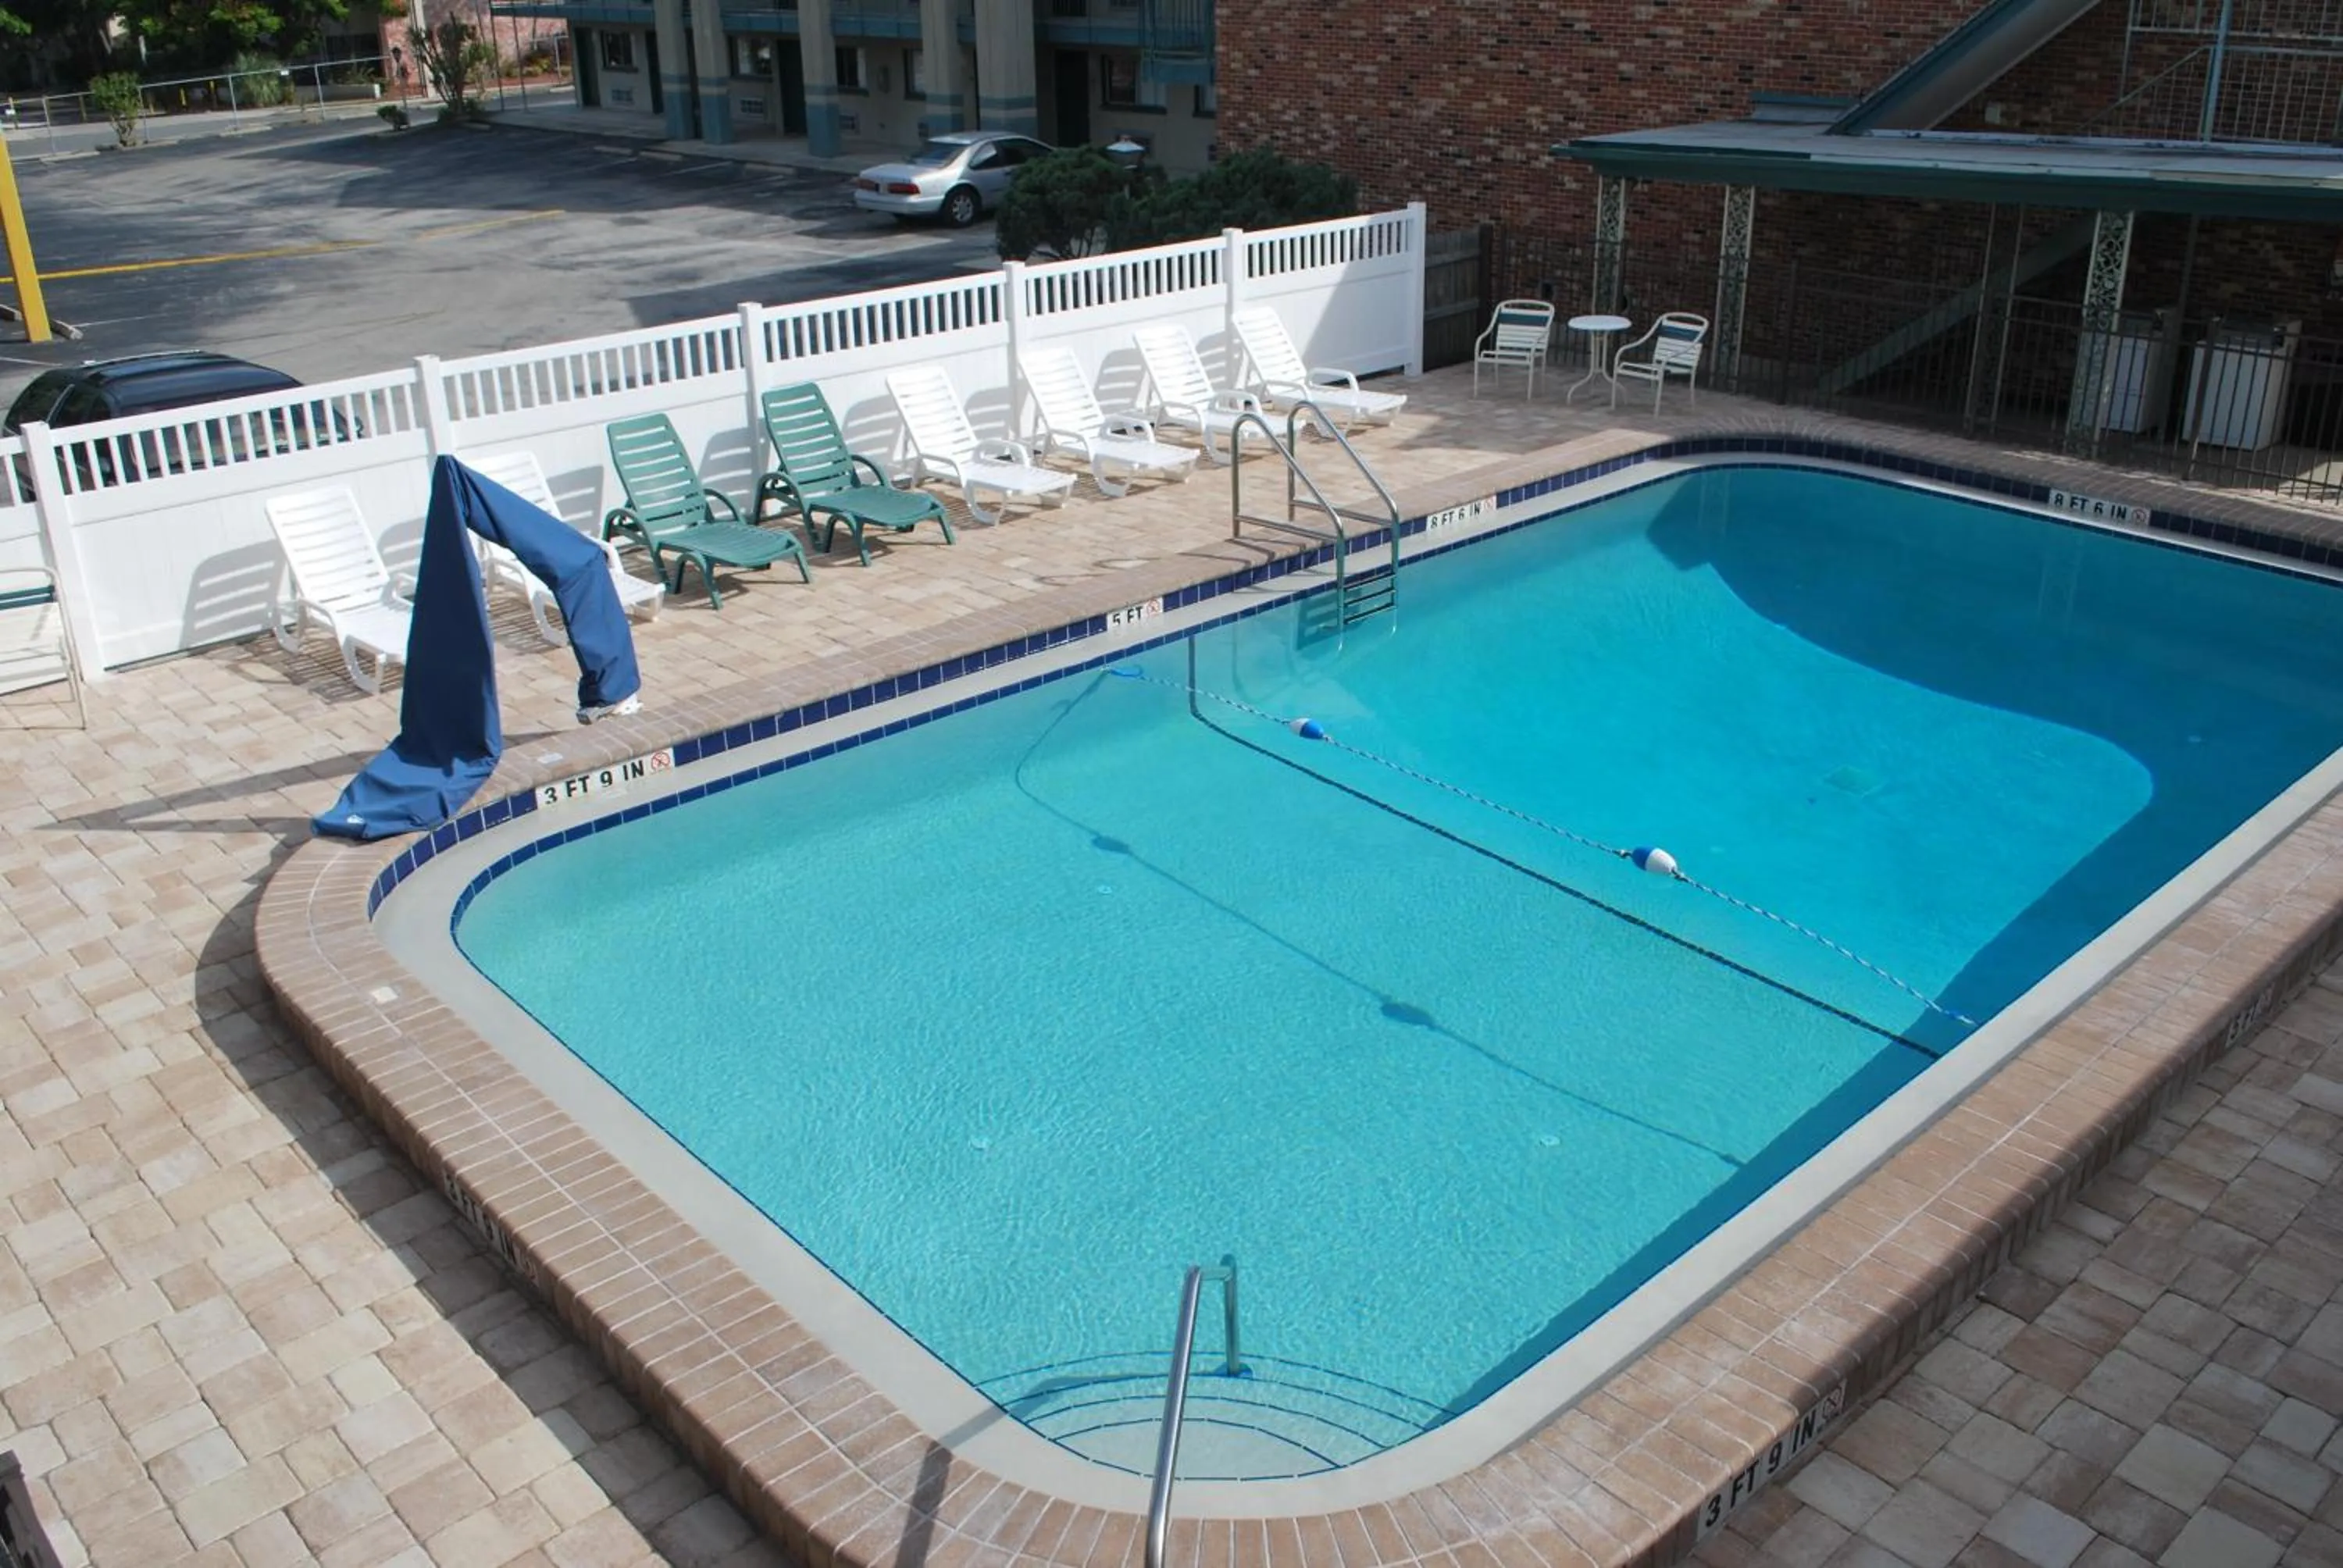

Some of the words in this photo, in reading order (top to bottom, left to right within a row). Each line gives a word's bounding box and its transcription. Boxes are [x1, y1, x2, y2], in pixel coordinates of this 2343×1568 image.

[1441, 511, 1454, 526] FT
[2070, 497, 2089, 511] FT
[2111, 504, 2127, 520] IN
[1127, 606, 1143, 623] FT
[544, 786, 558, 805] 3
[565, 775, 590, 797] FT
[600, 770, 613, 788] 9
[622, 760, 644, 782] IN
[1706, 1494, 1721, 1527] 3
[1730, 1458, 1760, 1509] FT
[1767, 1441, 1782, 1474] 9
